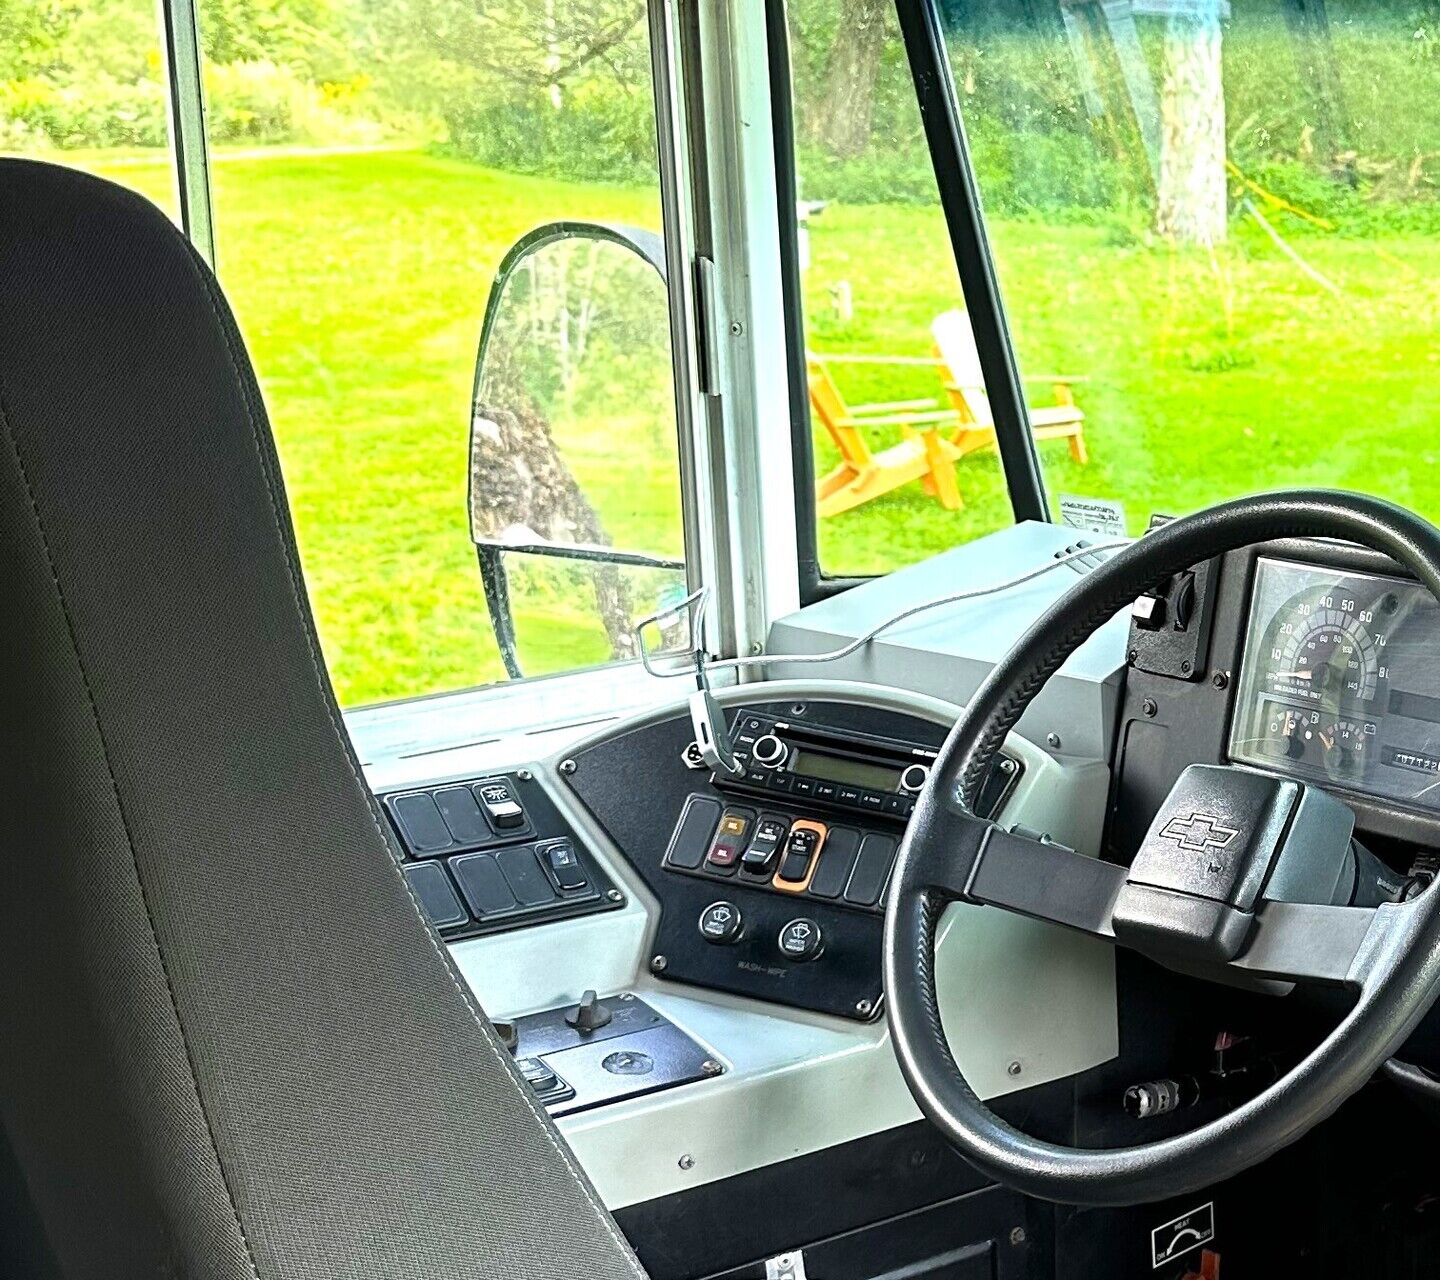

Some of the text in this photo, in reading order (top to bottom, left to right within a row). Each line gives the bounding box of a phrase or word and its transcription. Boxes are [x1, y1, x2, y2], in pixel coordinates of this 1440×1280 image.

[1319, 596, 1333, 608] 40
[1341, 600, 1354, 612] 50
[1297, 604, 1310, 615] 30
[1359, 611, 1372, 623] 60
[1280, 624, 1292, 634] 20
[1374, 634, 1386, 646] 70
[1271, 649, 1281, 661] 10
